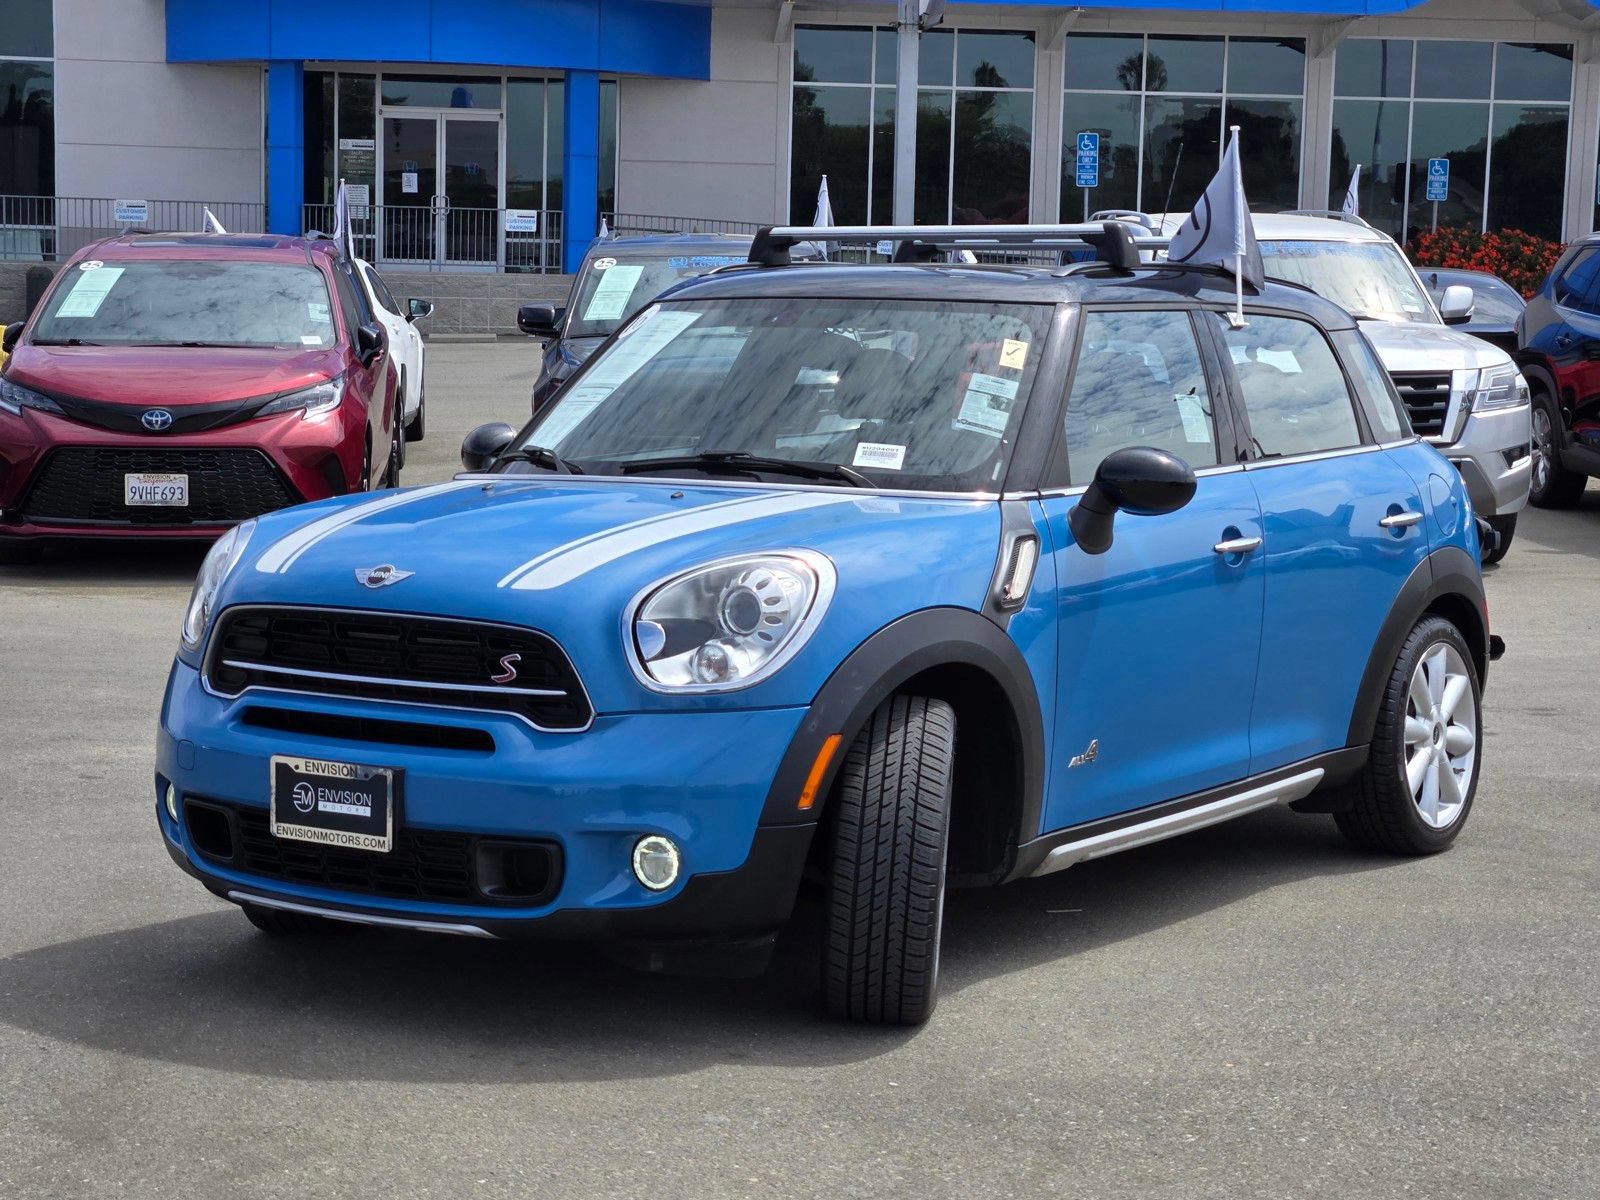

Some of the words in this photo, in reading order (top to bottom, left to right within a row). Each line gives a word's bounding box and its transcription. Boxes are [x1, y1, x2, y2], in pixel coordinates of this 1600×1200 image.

[130, 486, 184, 501] 9VHF693
[491, 653, 522, 684] S
[304, 761, 359, 778] ENVISION
[318, 787, 372, 807] ENVISION
[321, 803, 368, 815] MOTORS
[276, 825, 387, 850] ENVISIONMOTORS.COM
